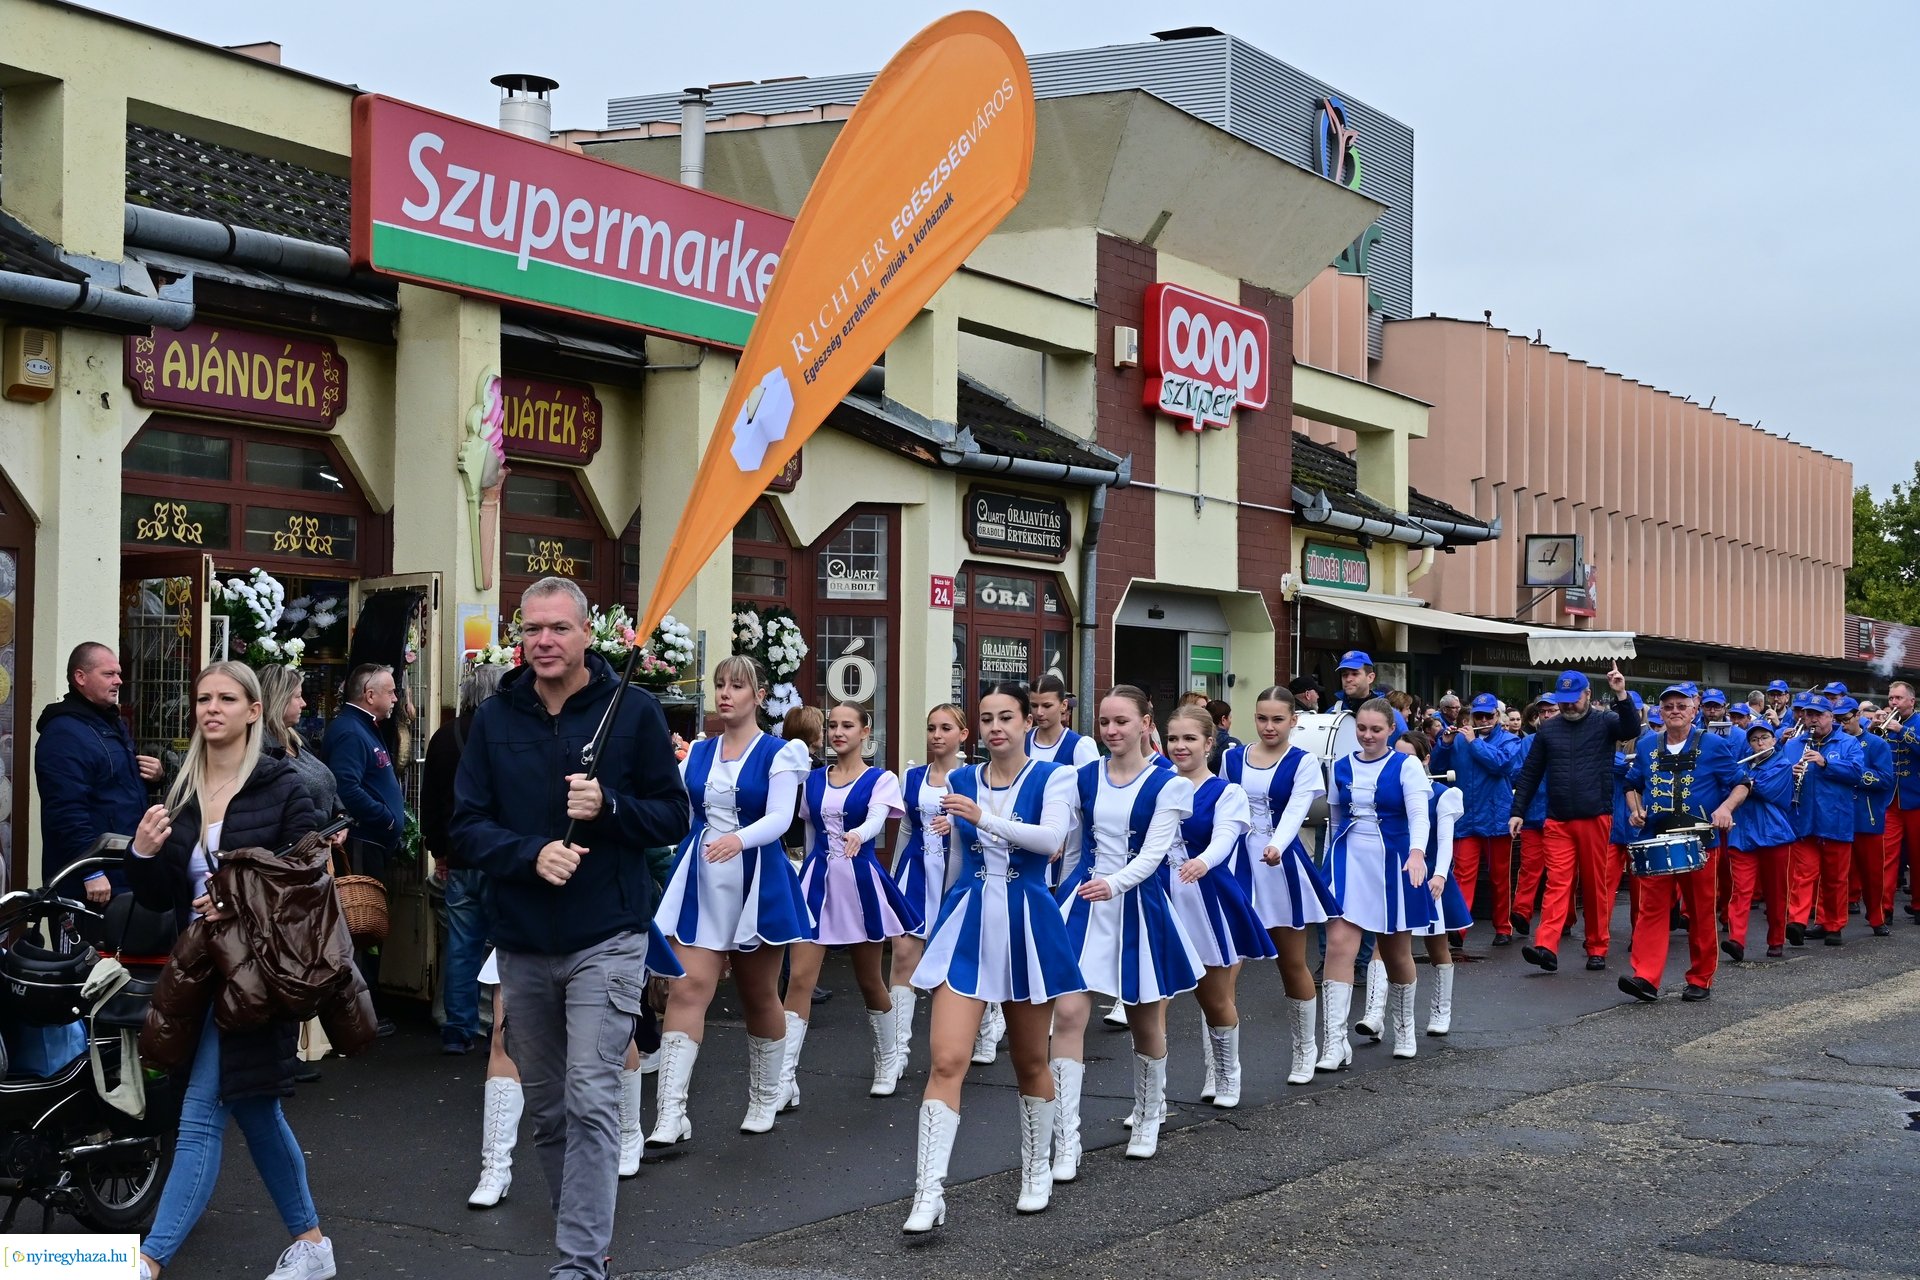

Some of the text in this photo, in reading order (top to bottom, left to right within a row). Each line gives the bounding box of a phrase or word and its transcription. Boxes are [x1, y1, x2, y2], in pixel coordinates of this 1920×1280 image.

[401, 131, 781, 304] Szupermarke
[790, 77, 1014, 365] RICHTER EGÉSZSÉGVÁROS
[803, 333, 842, 386] Egészség
[880, 249, 908, 289] milliók
[907, 243, 915, 255] a
[913, 191, 954, 246] kórháznak
[1168, 306, 1260, 403] coop
[162, 332, 316, 407] AJÁNDÉK
[1007, 504, 1060, 529] ÓRAJAVÍTÁS
[978, 525, 1004, 538] ÓRABOLT
[1007, 527, 1060, 548] ÉRTÉKESÍTÉS
[1306, 550, 1340, 583] ZÖLDSÉG
[829, 580, 876, 592] ÓRABOLT
[934, 587, 951, 605] 24.
[981, 581, 1030, 607] ÓRA
[982, 640, 1028, 658] ÓRAJAVÍTÁS
[982, 659, 1028, 674] ÉRTÉKESÍTÉS
